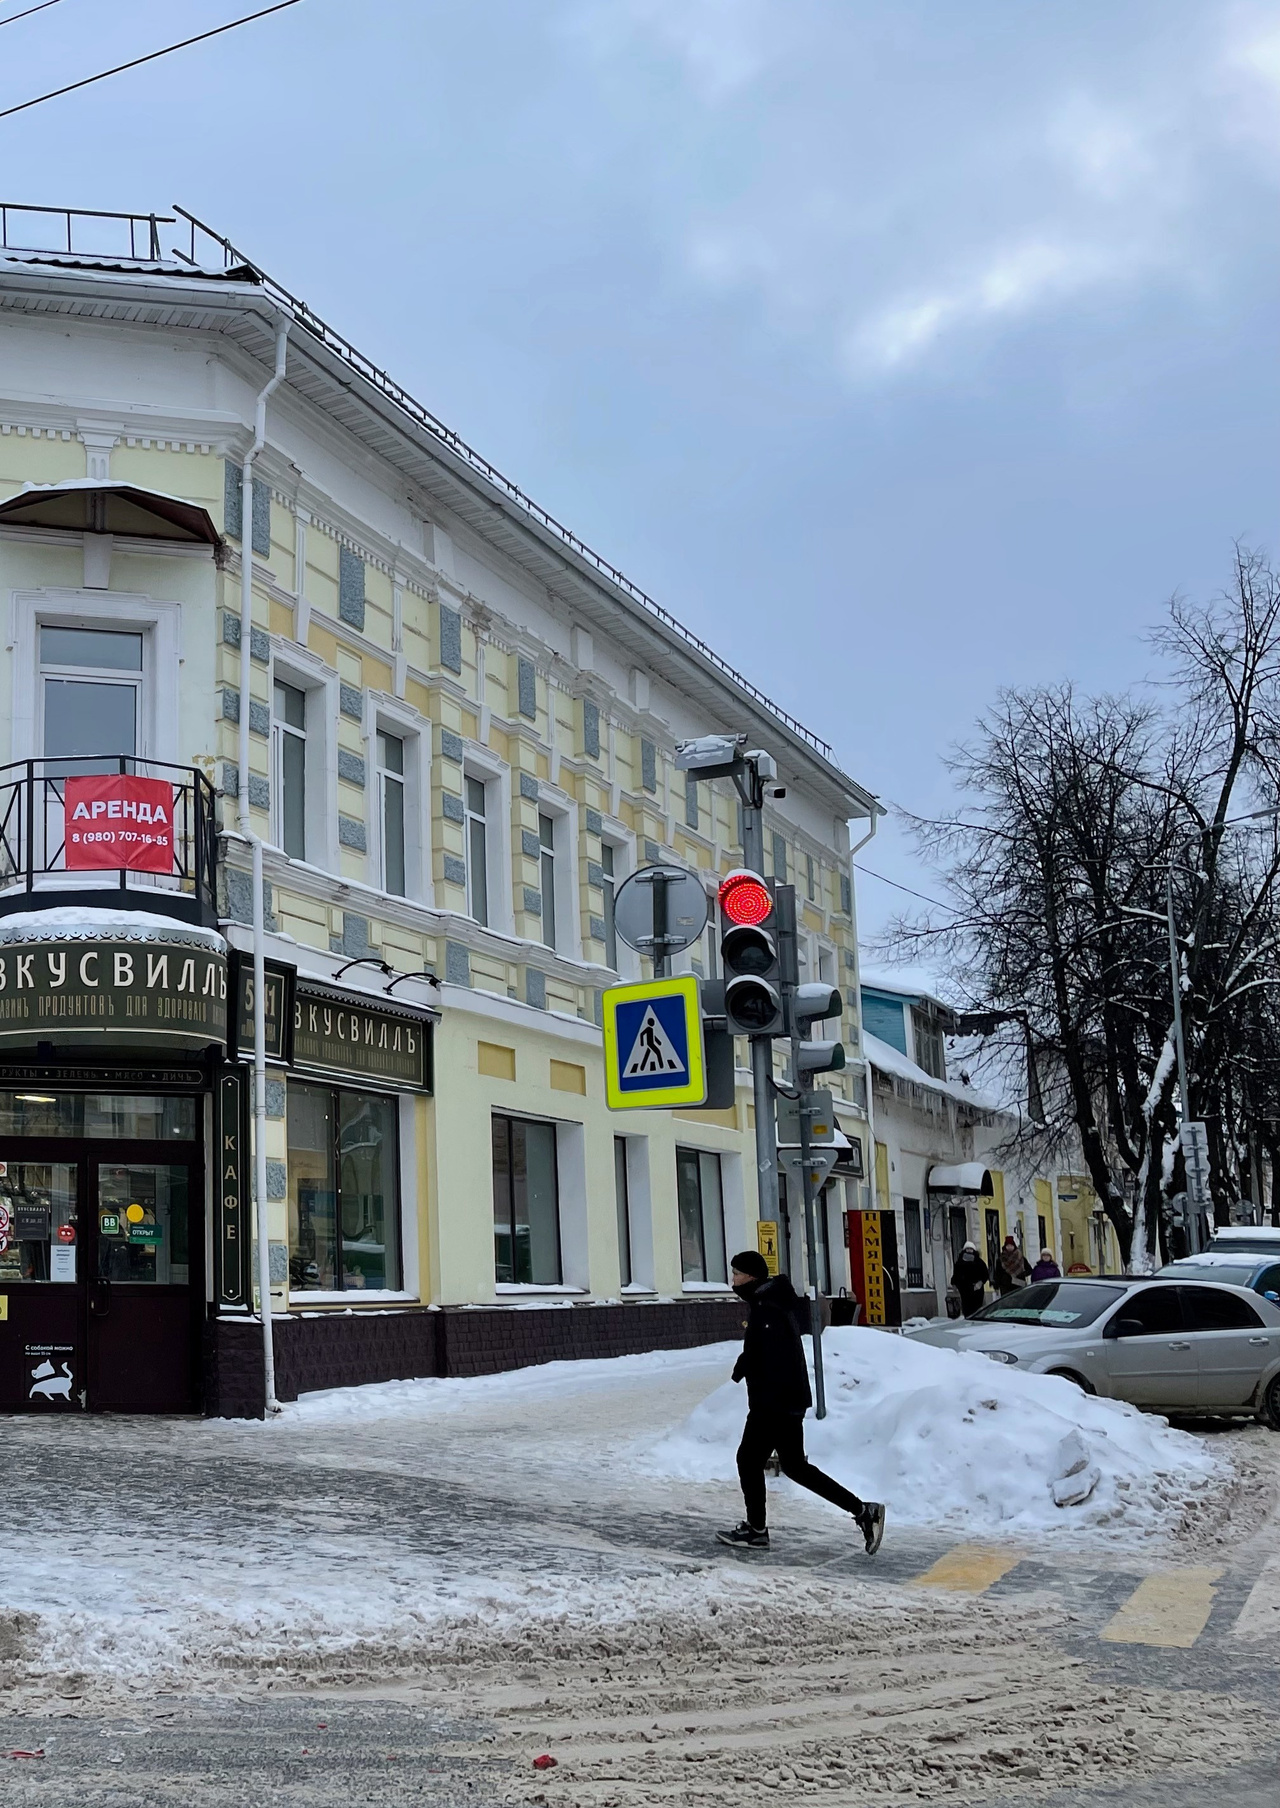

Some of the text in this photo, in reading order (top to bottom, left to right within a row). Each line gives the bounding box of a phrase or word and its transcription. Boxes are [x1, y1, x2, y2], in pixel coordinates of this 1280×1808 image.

[72, 800, 168, 824] АРЕНДА
[72, 831, 168, 846] 8 (980) 707-16-85
[126, 995, 148, 1017] ДЛЯ
[224, 1135, 237, 1240] КАФЕ
[864, 1212, 882, 1324] ПАМЯТНИКИ
